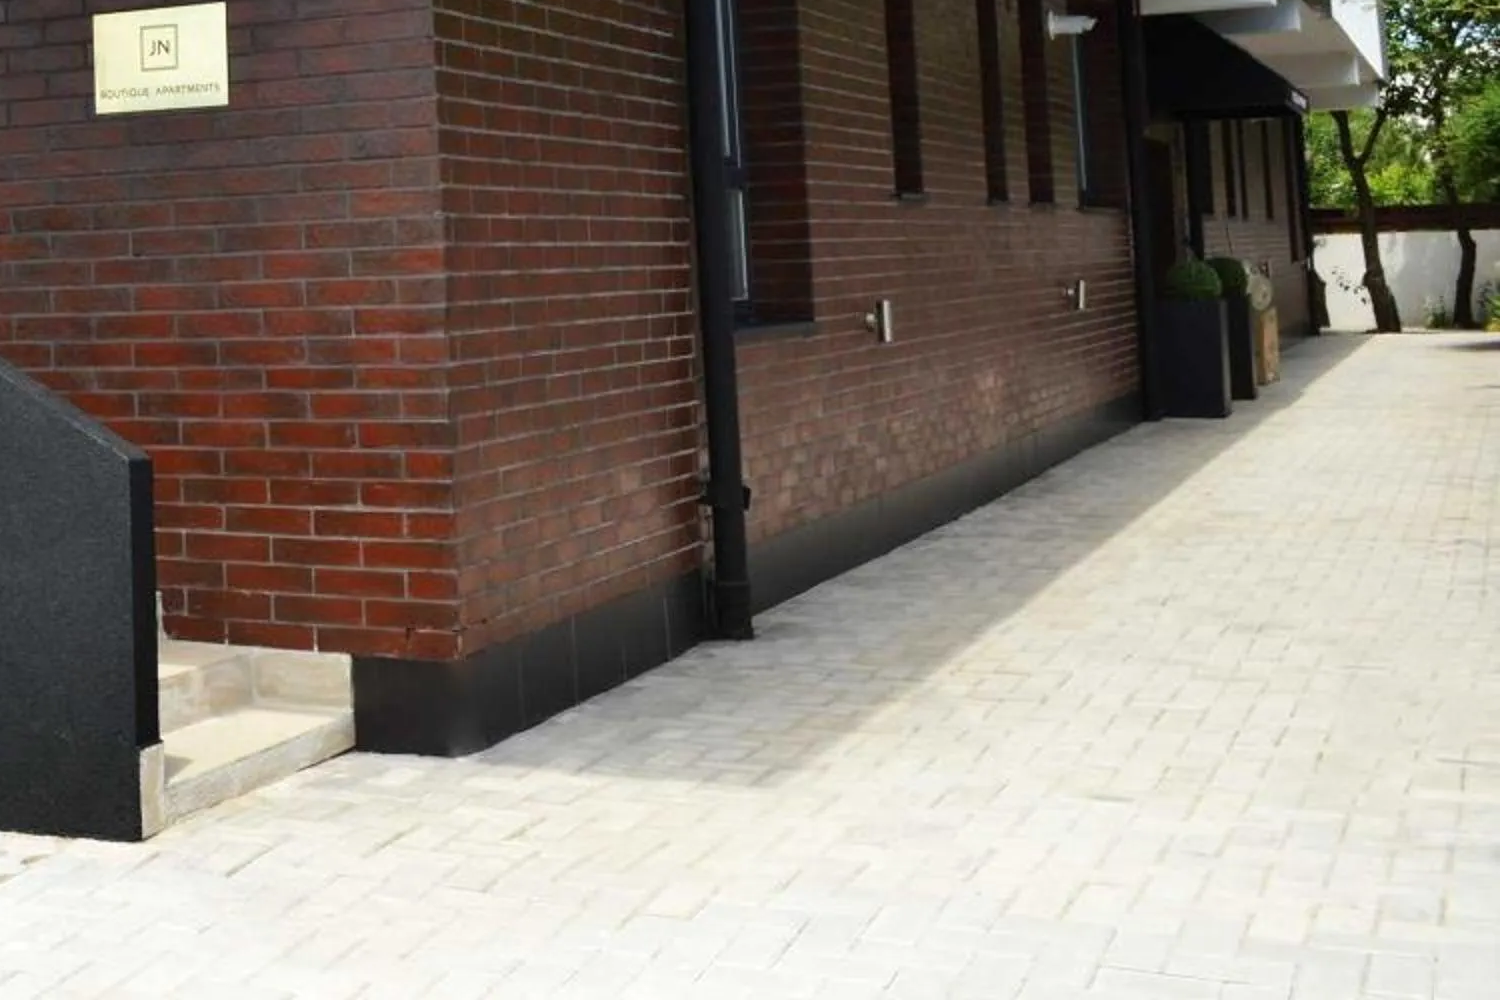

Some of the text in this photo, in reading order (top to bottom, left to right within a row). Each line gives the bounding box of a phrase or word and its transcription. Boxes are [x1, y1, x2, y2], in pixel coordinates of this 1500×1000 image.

[149, 39, 171, 57] JN
[100, 83, 221, 100] BOUTIQUE APARTMENTS
